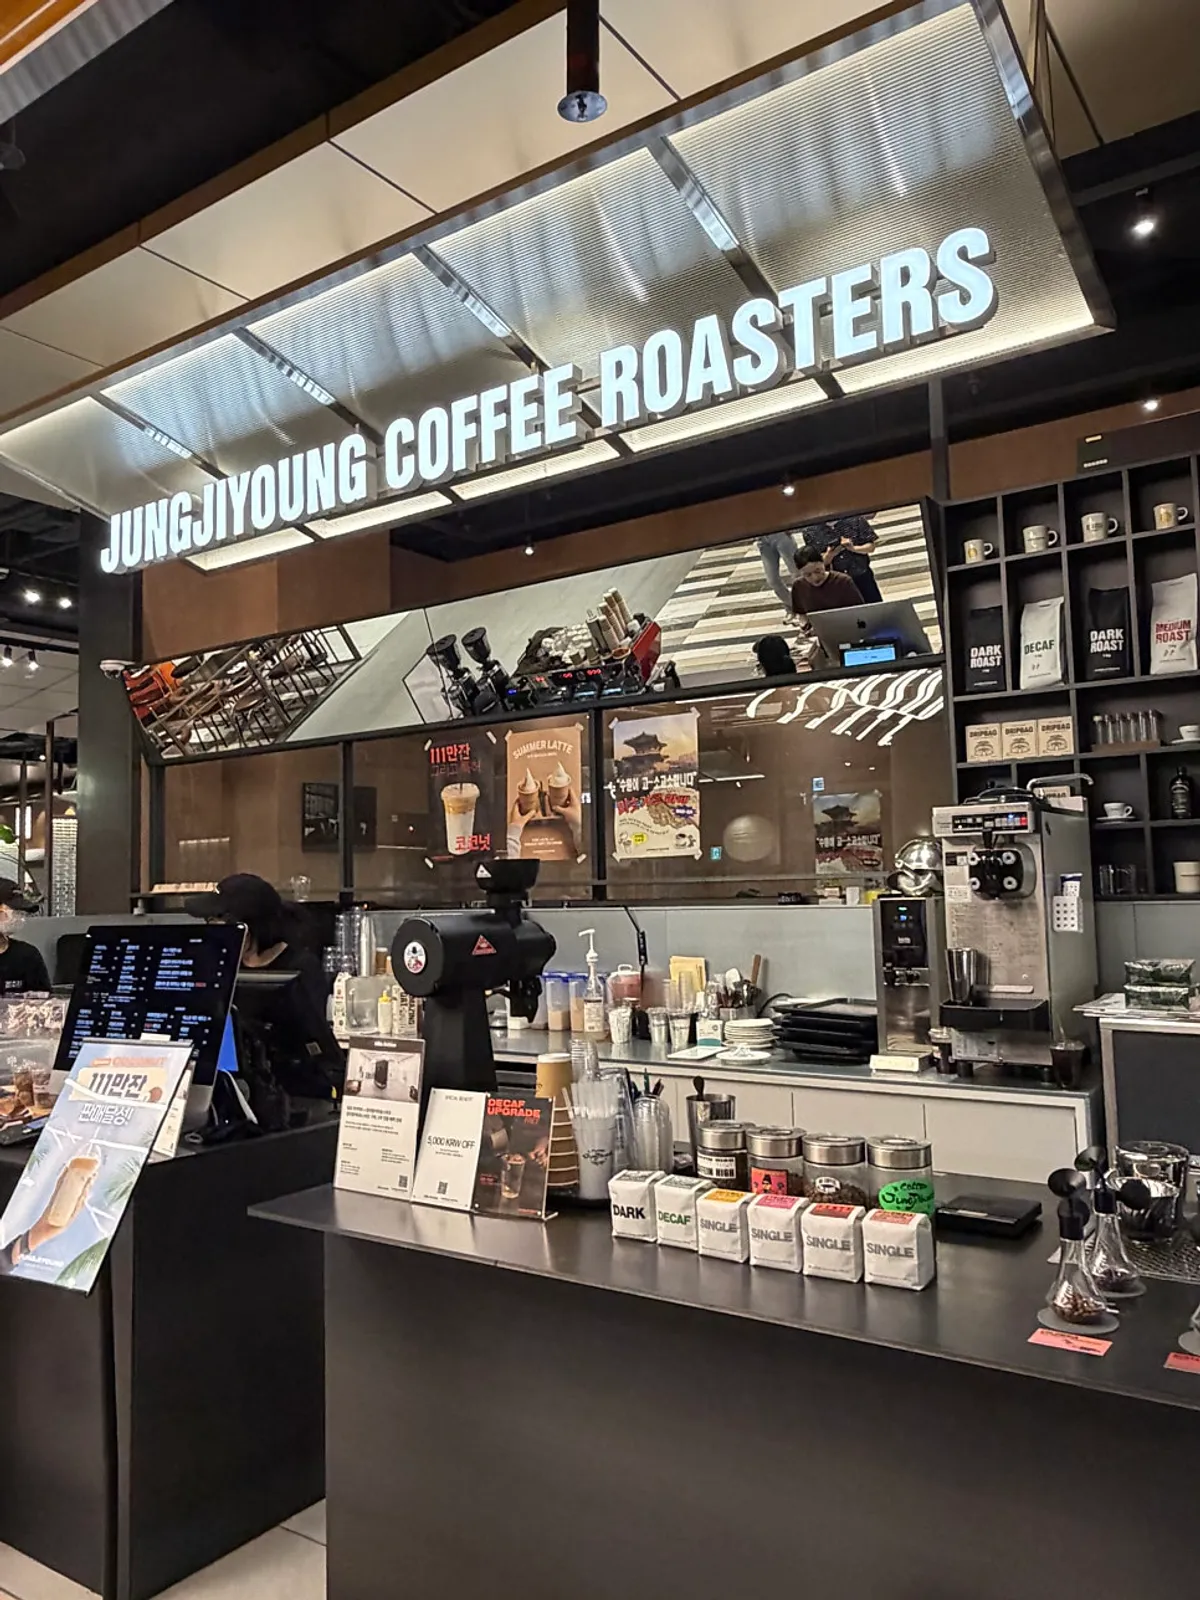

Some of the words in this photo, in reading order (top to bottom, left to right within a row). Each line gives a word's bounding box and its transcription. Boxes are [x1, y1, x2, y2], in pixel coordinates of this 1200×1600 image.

[100, 433, 368, 575] JUNGJIYOUNG
[384, 363, 582, 491] COFFEE
[600, 228, 996, 429] ROASTERS
[1156, 619, 1191, 634] MEDIUM
[1090, 628, 1124, 642] DARK
[1156, 630, 1191, 645] ROAST
[970, 645, 1002, 658] DARK
[1024, 639, 1055, 655] DECAF
[1090, 639, 1125, 653] ROAST
[970, 656, 1002, 669] ROAST
[969, 729, 998, 738] DRIPBAG
[1005, 726, 1034, 735] DRIPBAG
[1041, 722, 1071, 732] DRIPBAG
[512, 740, 546, 760] SUMMER
[547, 739, 574, 754] LATTE
[89, 1073, 148, 1098] 111만잔
[487, 1098, 526, 1108] DECAF
[487, 1106, 541, 1118] UPGRADE
[428, 1136, 446, 1147] 5,000
[446, 1137, 461, 1148] KRW
[462, 1140, 476, 1150] OFF
[613, 1204, 646, 1219] DARK
[658, 1211, 691, 1226] DECAF
[700, 1218, 738, 1233] SINGLE
[751, 1228, 793, 1243] SINGLE
[806, 1235, 851, 1251] SINGLE
[867, 1242, 914, 1259] SINGLE
